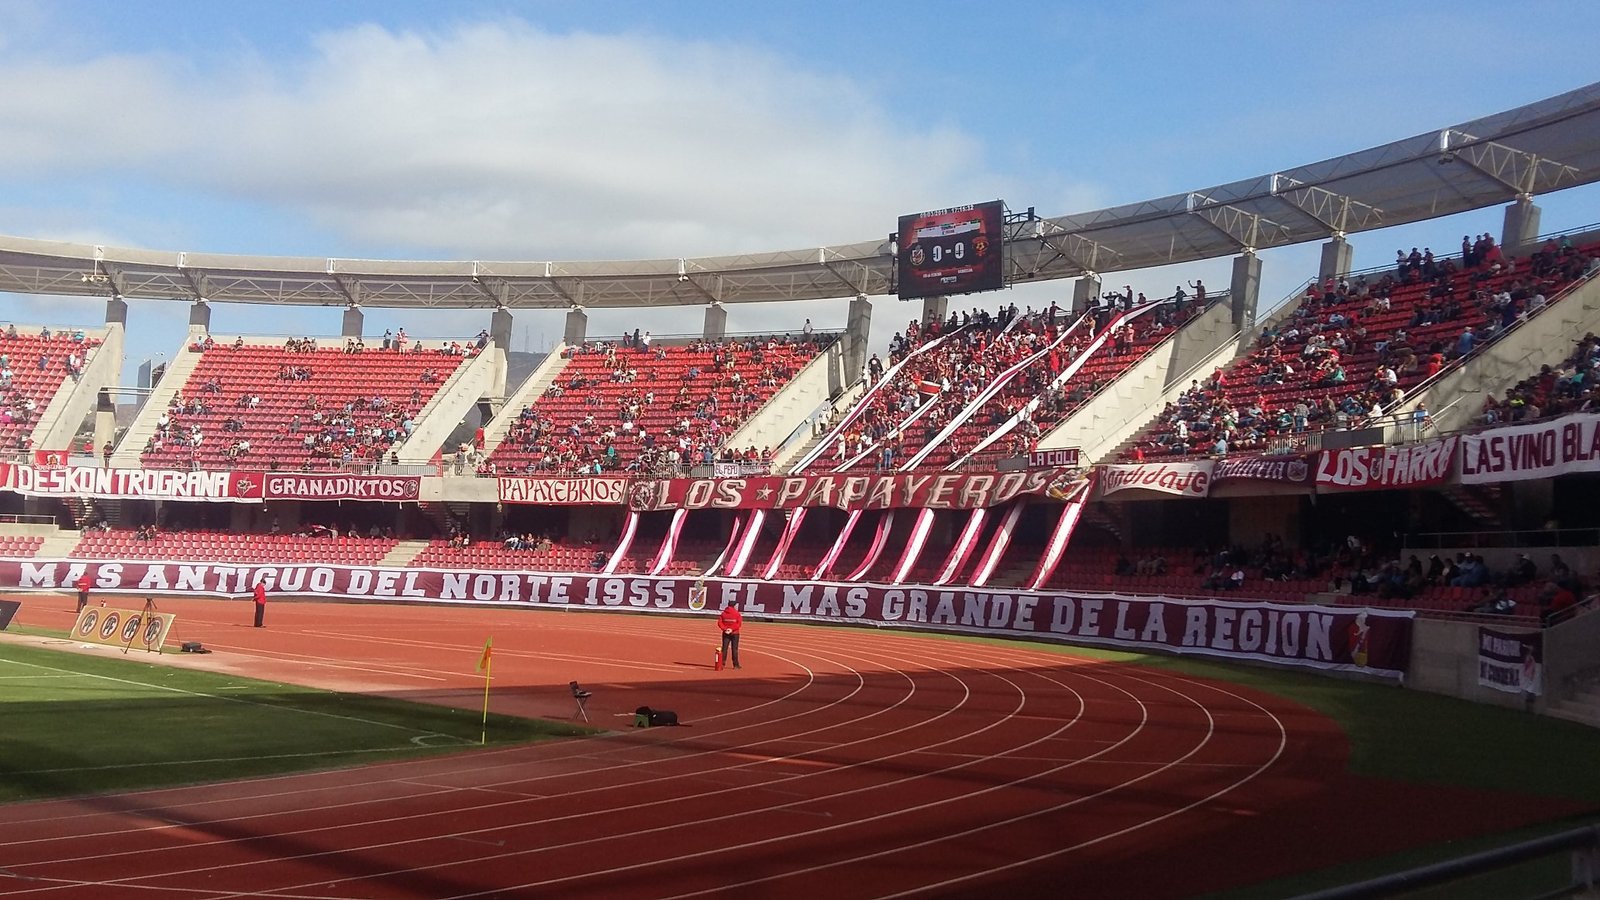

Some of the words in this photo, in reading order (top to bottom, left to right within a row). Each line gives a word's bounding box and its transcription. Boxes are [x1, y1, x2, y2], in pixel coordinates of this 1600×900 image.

[1028, 452, 1044, 467] LA
[1316, 450, 1370, 486] LOS
[1462, 436, 1506, 475] LAS
[1508, 429, 1557, 471] VINO
[269, 477, 405, 497] GRANADIKTOS
[501, 478, 622, 502] PAPAYEBRIOS
[653, 479, 746, 511] LOS
[774, 469, 1057, 509] PAPAYEROS
[18, 562, 124, 588] MAS
[138, 564, 335, 593] ANTIGUO
[346, 570, 426, 597] DEL
[440, 573, 572, 604] NORTE
[584, 578, 675, 608] 1955
[719, 583, 765, 612] EL
[780, 585, 867, 618] MAS
[881, 589, 1041, 631] GRANDE
[1050, 597, 1103, 637] DE
[1114, 602, 1168, 642] LA
[1182, 607, 1333, 660] REGION
